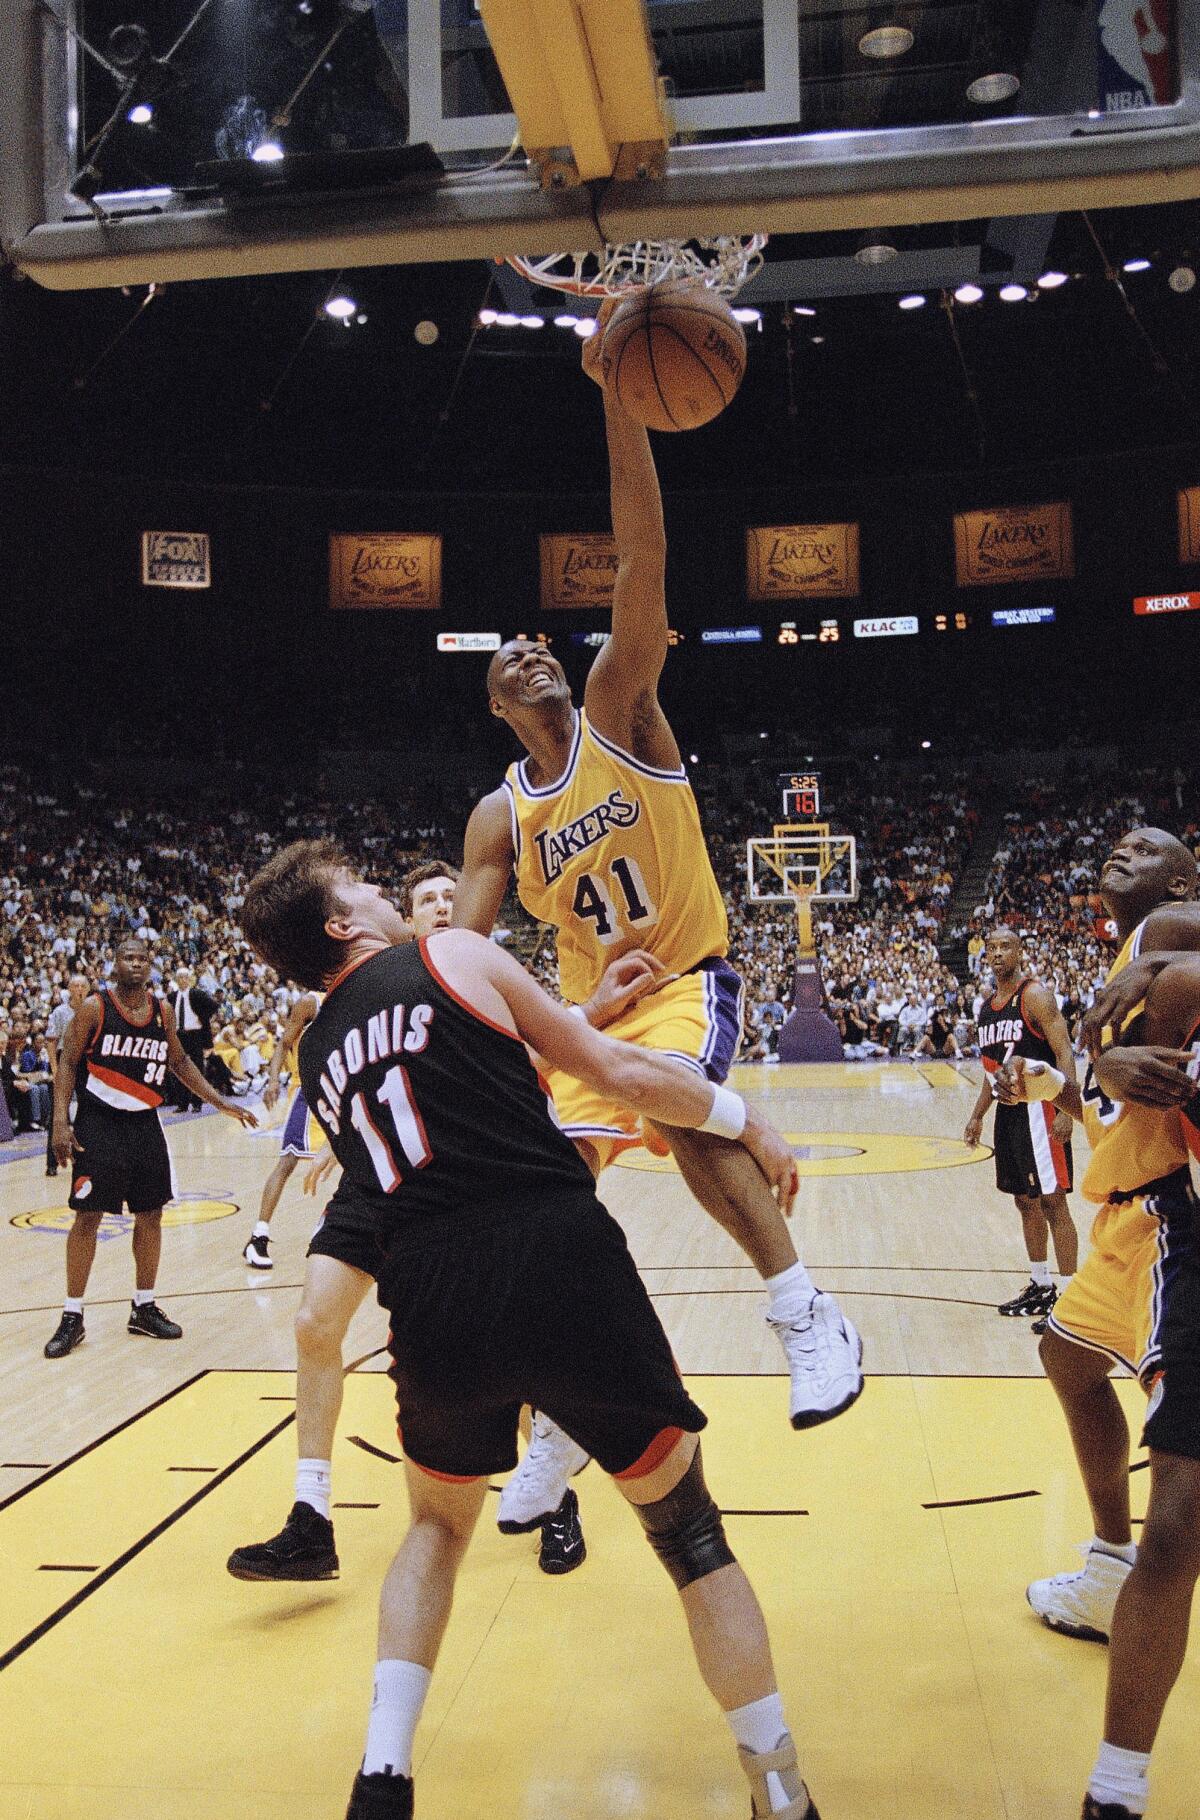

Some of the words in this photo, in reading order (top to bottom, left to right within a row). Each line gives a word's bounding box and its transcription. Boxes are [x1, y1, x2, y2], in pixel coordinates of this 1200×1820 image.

[1105, 90, 1144, 112] NBA
[351, 548, 420, 577] LAKERS
[768, 539, 835, 564] LAKERS
[1146, 596, 1189, 611] XEROX
[860, 620, 897, 633] KLAC
[458, 637, 496, 648] Marlboro
[791, 776, 818, 789] 5:25
[795, 791, 815, 814] 16
[534, 790, 640, 887] LAKERS
[572, 856, 656, 943] 41
[978, 1020, 1023, 1048] BLAZERS
[101, 1034, 168, 1062] BLAZERS
[1003, 1042, 1015, 1064] 7
[144, 1062, 166, 1086] 34
[317, 1003, 434, 1136] SABONIS
[351, 1065, 433, 1194] 11
